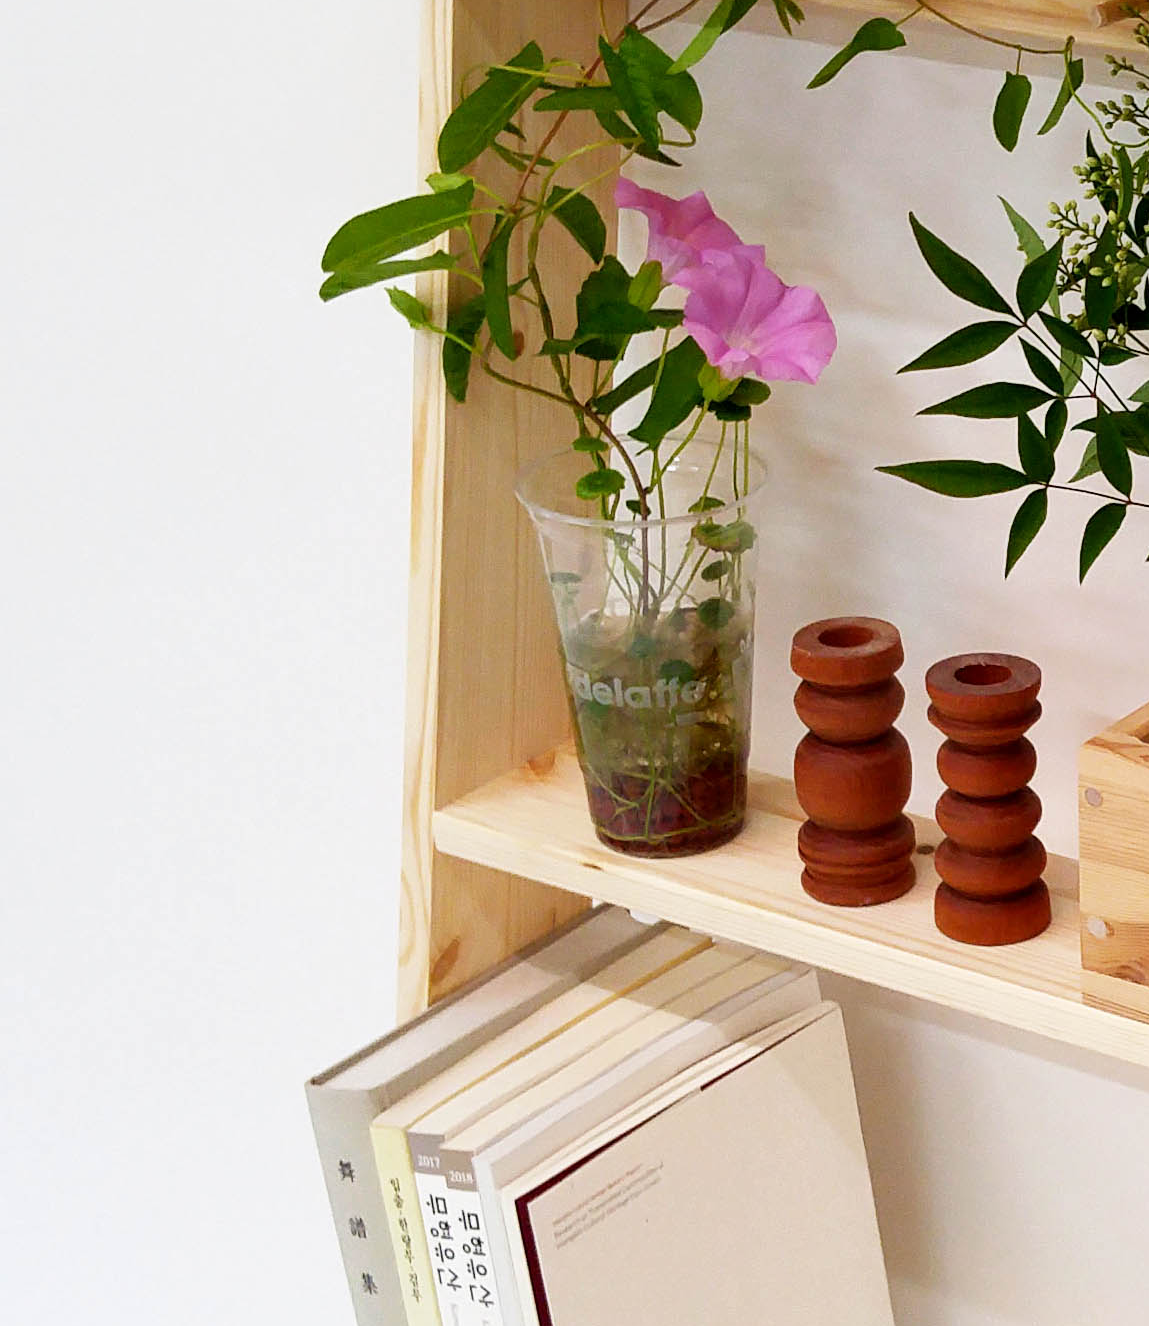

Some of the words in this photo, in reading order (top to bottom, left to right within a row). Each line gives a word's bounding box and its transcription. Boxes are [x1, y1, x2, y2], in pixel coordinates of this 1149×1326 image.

[417, 1154, 441, 1170] 2017
[425, 1193, 463, 1292] 무형유산
[458, 1209, 496, 1308] 무형유산
